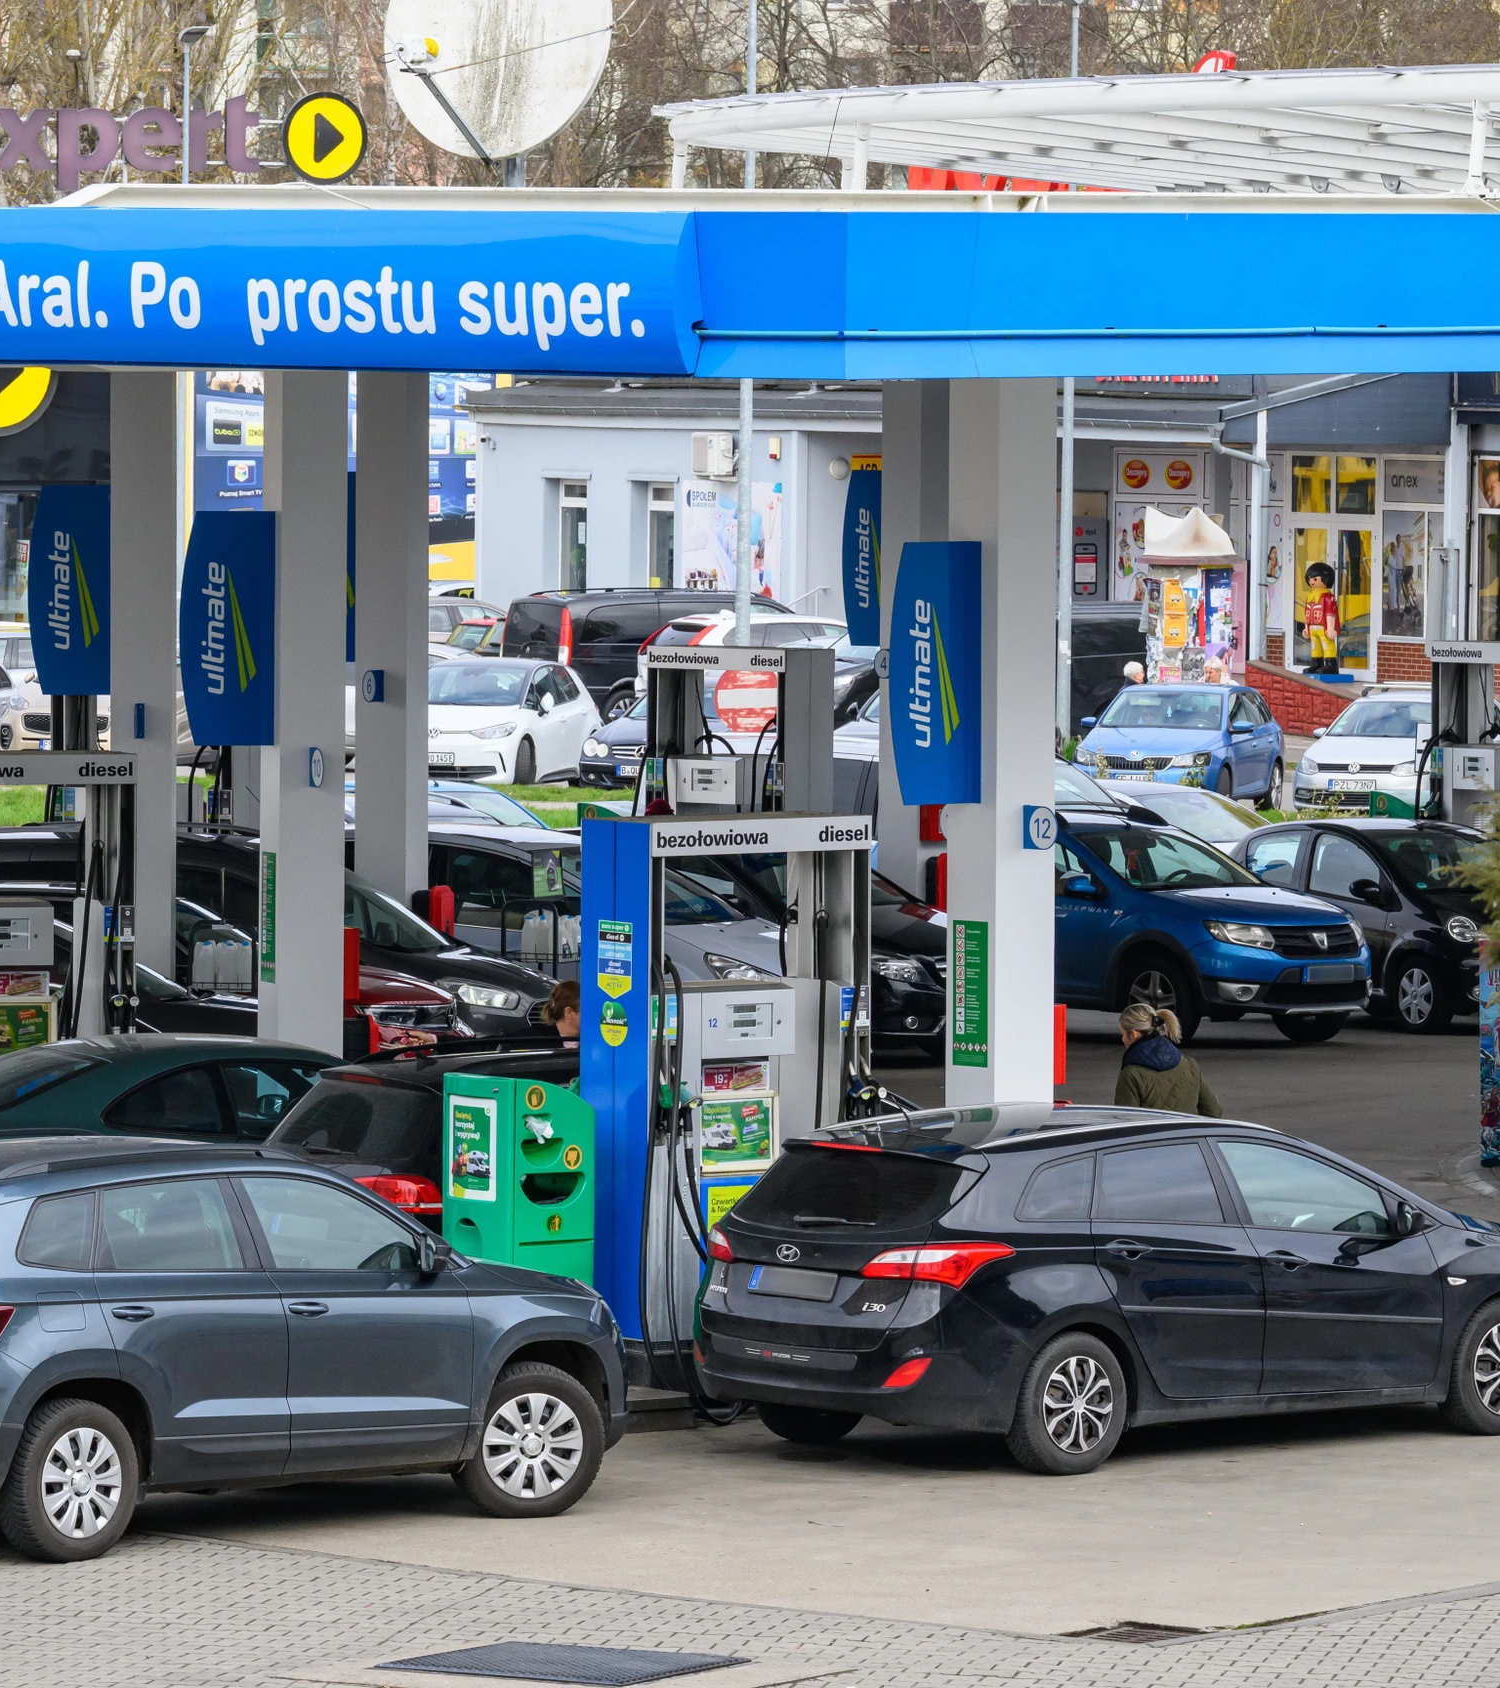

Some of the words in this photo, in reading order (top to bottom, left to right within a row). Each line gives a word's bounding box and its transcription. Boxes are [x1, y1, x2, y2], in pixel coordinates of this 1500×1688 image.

[129, 260, 201, 330] Po
[247, 265, 436, 346] prostu
[459, 279, 646, 351] super.
[1391, 474, 1418, 488] anex
[854, 507, 871, 608] ultimate
[48, 530, 71, 650] ultimate
[200, 561, 227, 695] ultimate
[648, 651, 720, 667] bezołowiowa
[750, 653, 783, 668] diesel
[1432, 646, 1482, 659] bezołowiowa
[880, 657, 888, 672] 4
[902, 598, 932, 749] ultimate
[366, 678, 373, 695] 6
[78, 760, 134, 777] diesel
[312, 757, 322, 779] 10
[1333, 780, 1351, 790] PZL
[1354, 781, 1374, 790] 73N7
[656, 829, 769, 848] bezołowiowa
[818, 825, 869, 843] diesel
[1033, 818, 1051, 839] 12
[708, 1018, 718, 1028] 12
[714, 1073, 724, 1084] 19
[862, 1302, 887, 1313] i30
